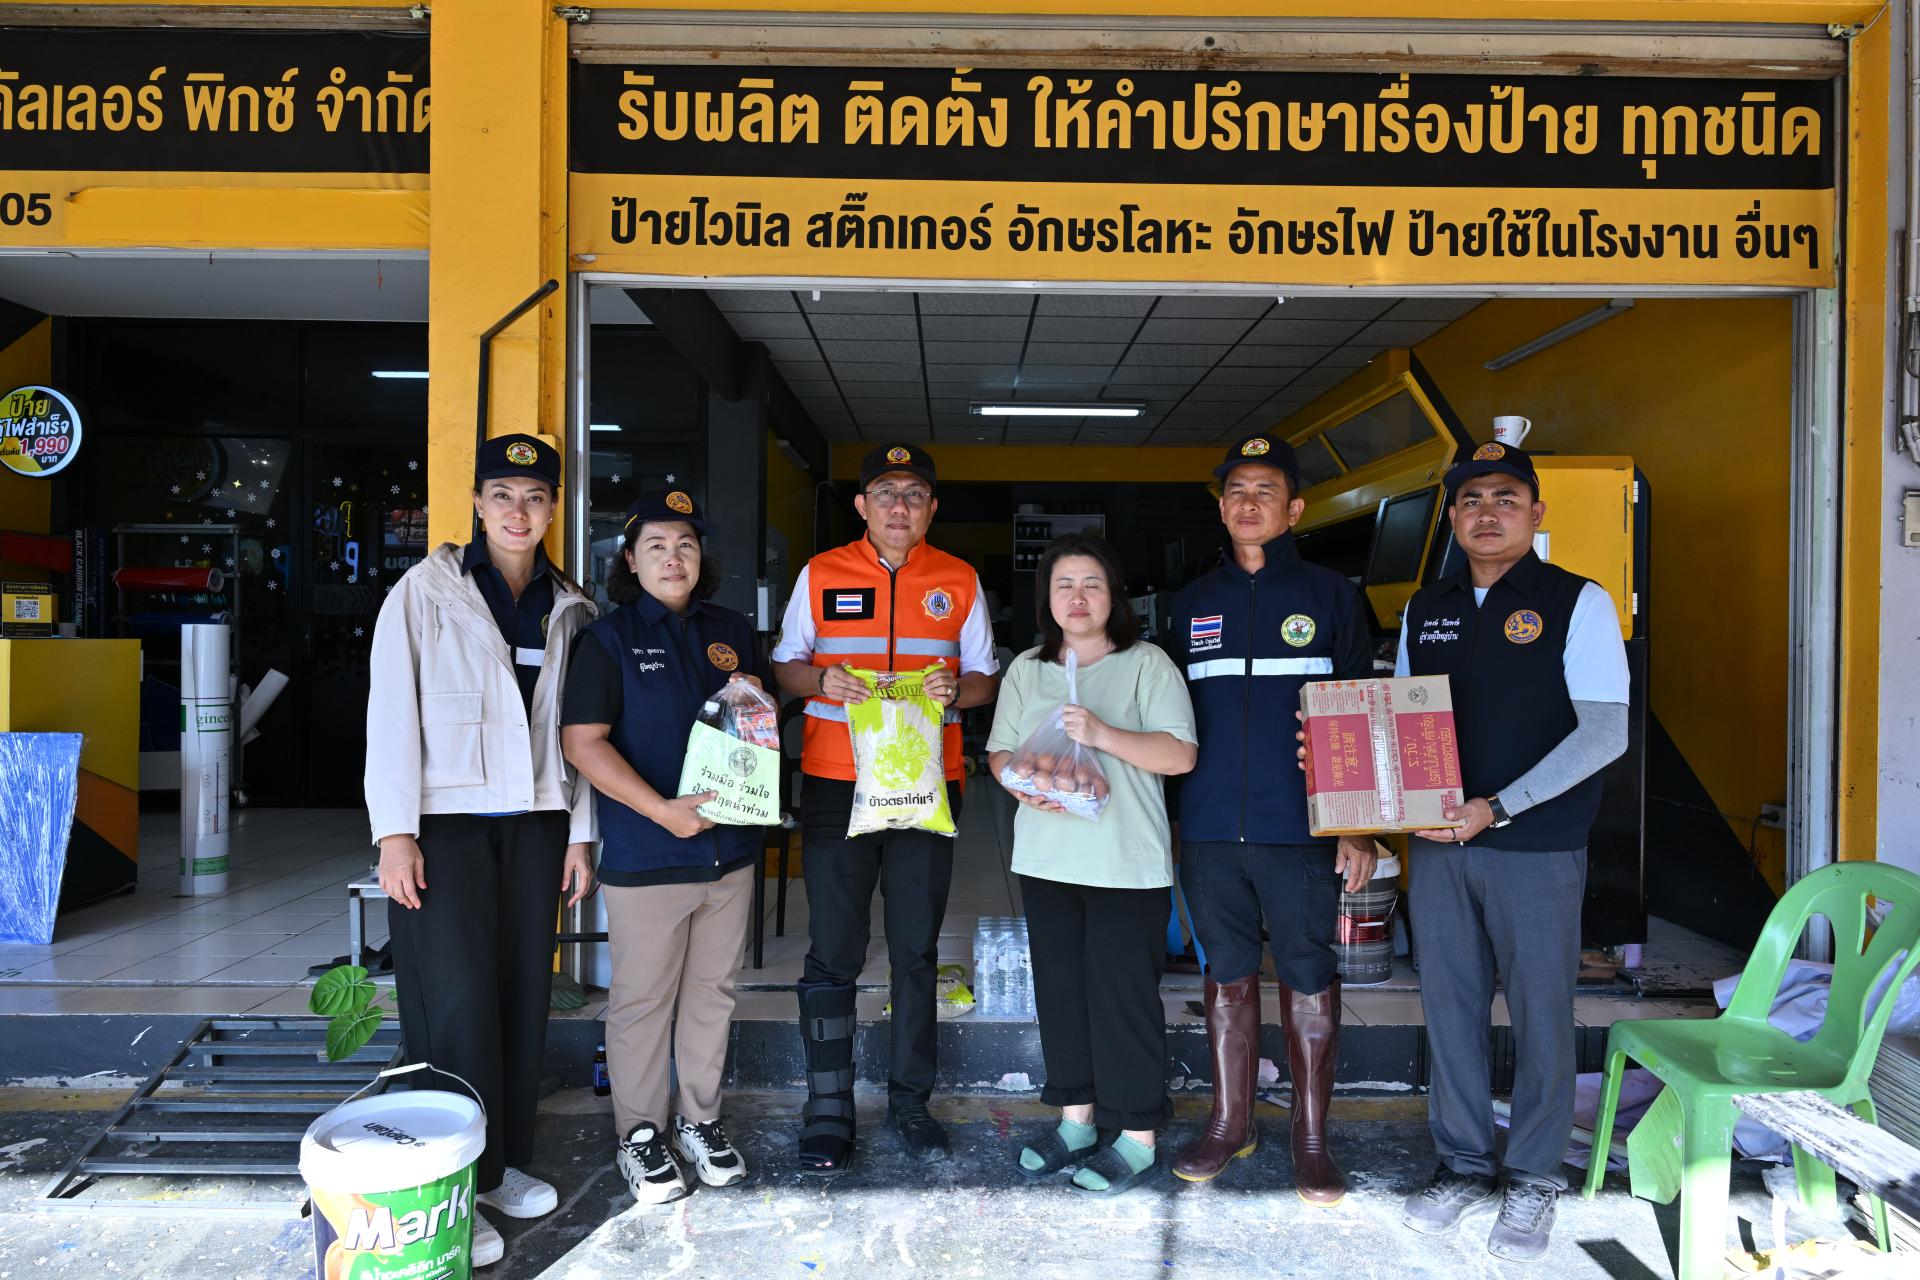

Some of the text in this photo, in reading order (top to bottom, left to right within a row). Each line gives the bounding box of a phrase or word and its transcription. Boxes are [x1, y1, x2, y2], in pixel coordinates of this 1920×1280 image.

[183, 67, 299, 132] พิกซ์
[617, 68, 1821, 180] รับผลิต ติดตั้ง ให้คำปรึกษาเรื่องป้าย ทุกชนิด
[610, 192, 1820, 270] ป้ายไวนิล สติ๊กเกอร์ อักษรโลหะ อักษรไฟ ป้ายใช้ในโรงงาน อื่นๆ
[10, 394, 50, 418] ป้าย
[20, 436, 69, 458] 1,990
[41, 455, 58, 463] บาท
[75, 529, 83, 557] BLACK
[75, 558, 83, 592] CARBON
[701, 765, 769, 798] ร่วมมือ ร่วมใจ
[869, 791, 934, 807] ข้าวตราไก่แจ้
[362, 1121, 417, 1145] Captain
[344, 1184, 471, 1250] Mark
